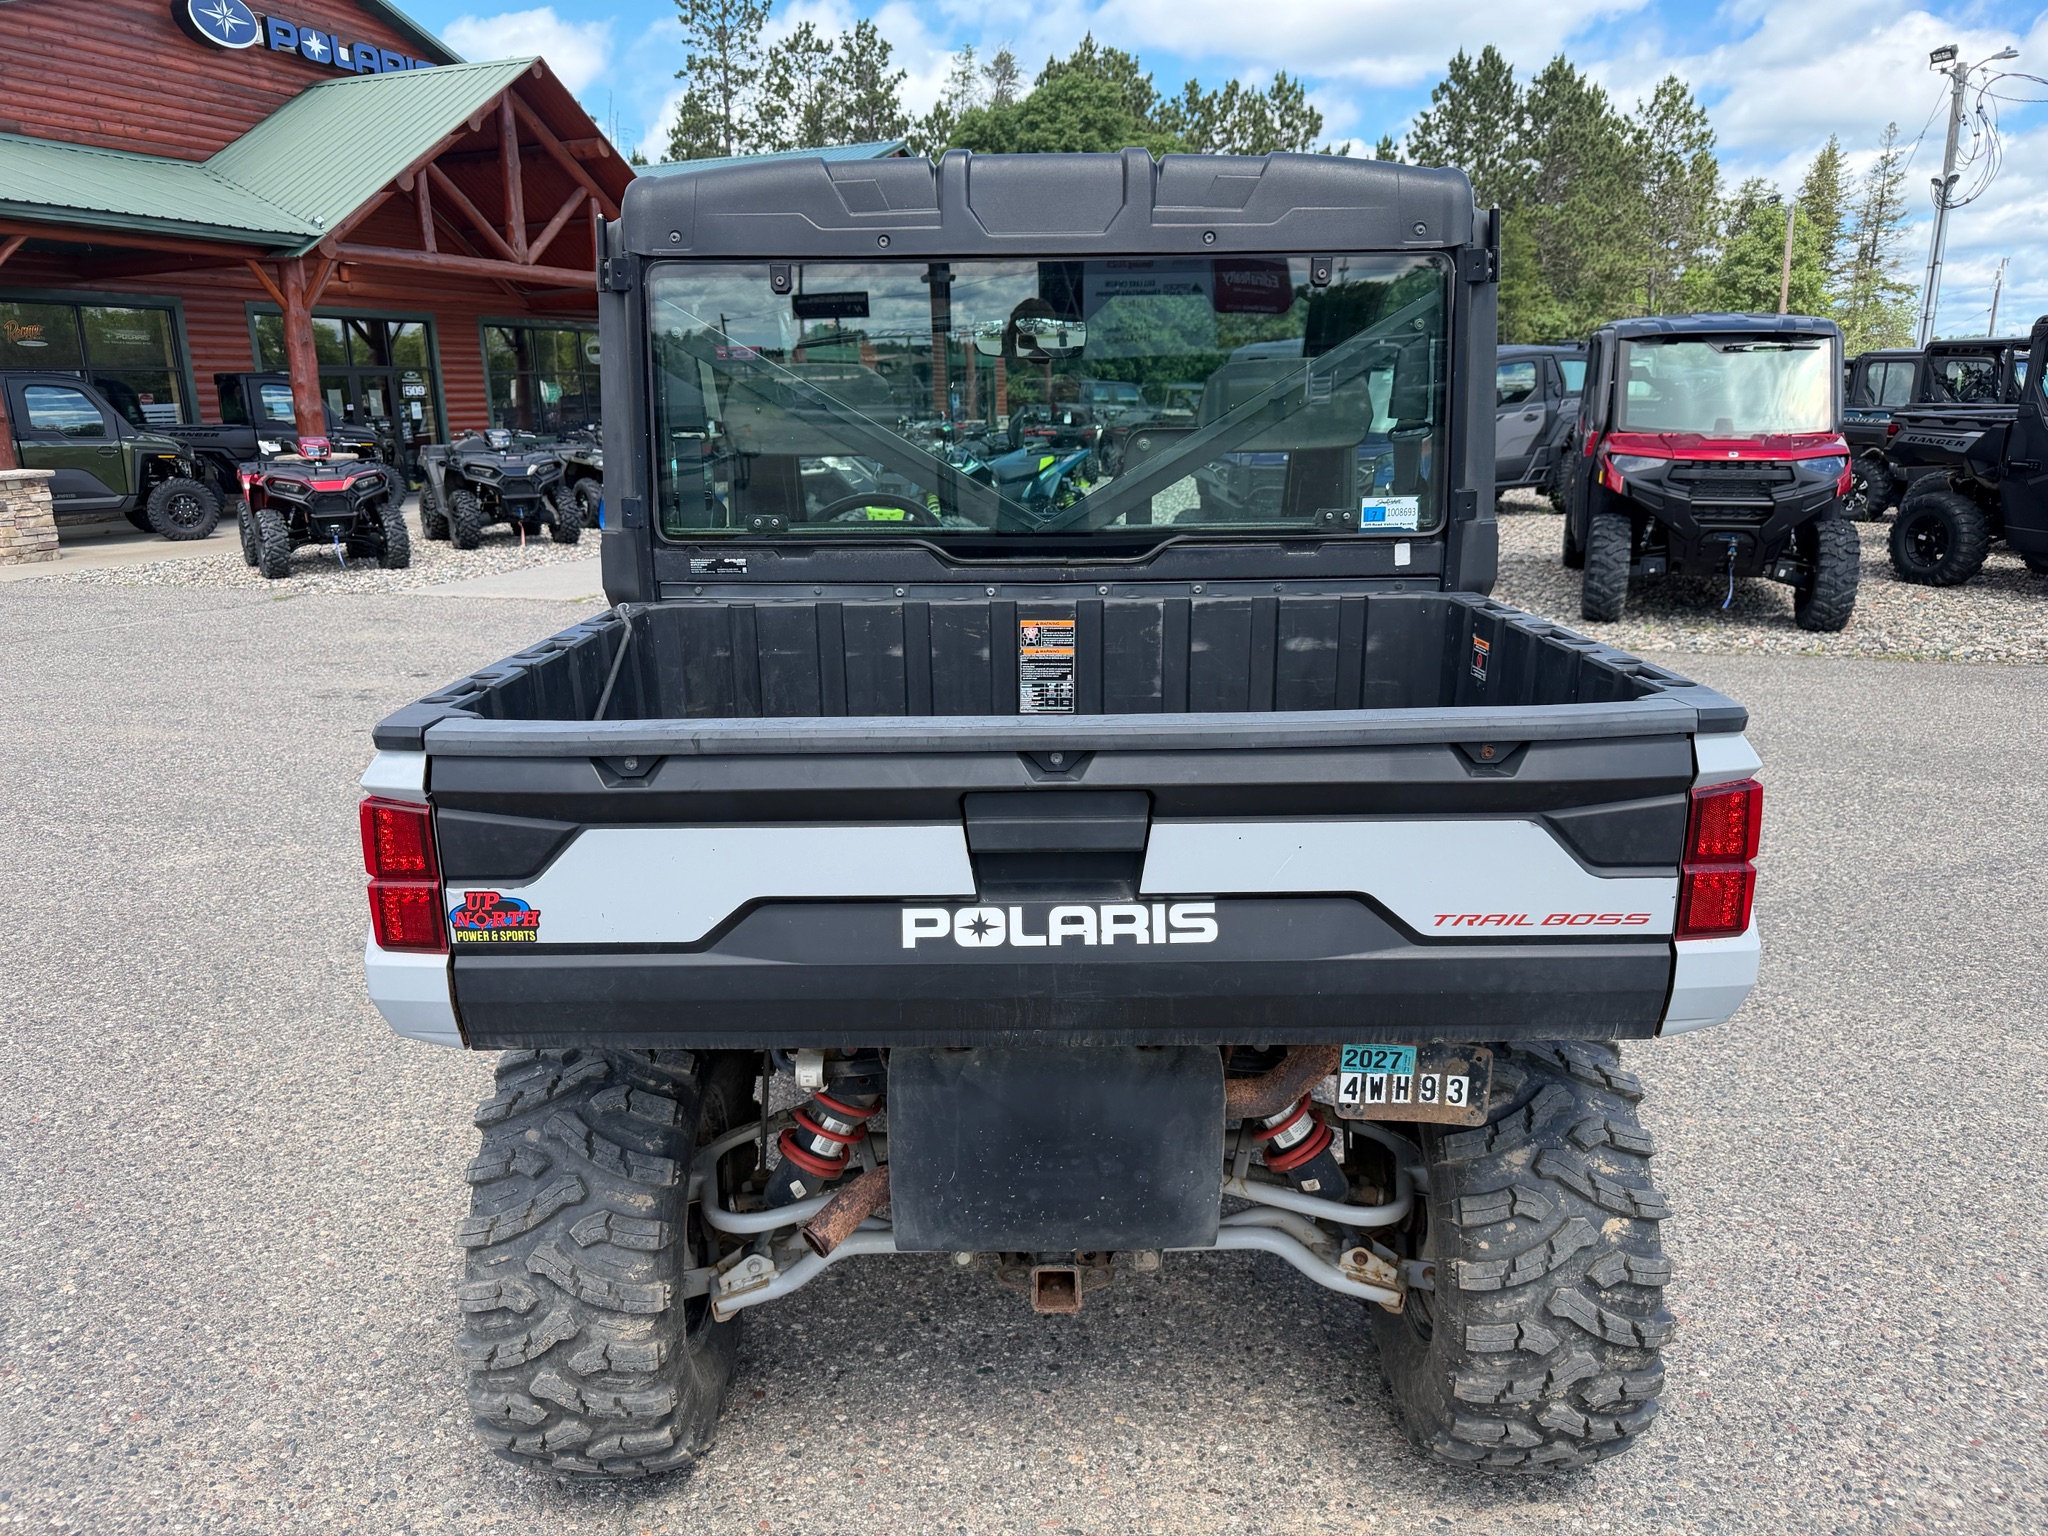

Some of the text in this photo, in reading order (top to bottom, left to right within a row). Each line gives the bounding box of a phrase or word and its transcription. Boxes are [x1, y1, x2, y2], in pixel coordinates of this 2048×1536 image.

[266, 16, 437, 73] POLARI
[405, 385, 426, 396] 509
[1908, 435, 1967, 447] RANGER
[1387, 507, 1417, 517] 1008693
[465, 892, 500, 911] UP
[453, 911, 539, 928] NORTH
[902, 902, 1219, 949] POLARIS
[1433, 913, 1652, 927] TRAIL BOSS
[457, 930, 537, 942] POWER & SPORTS
[1343, 1049, 1403, 1069] 2027
